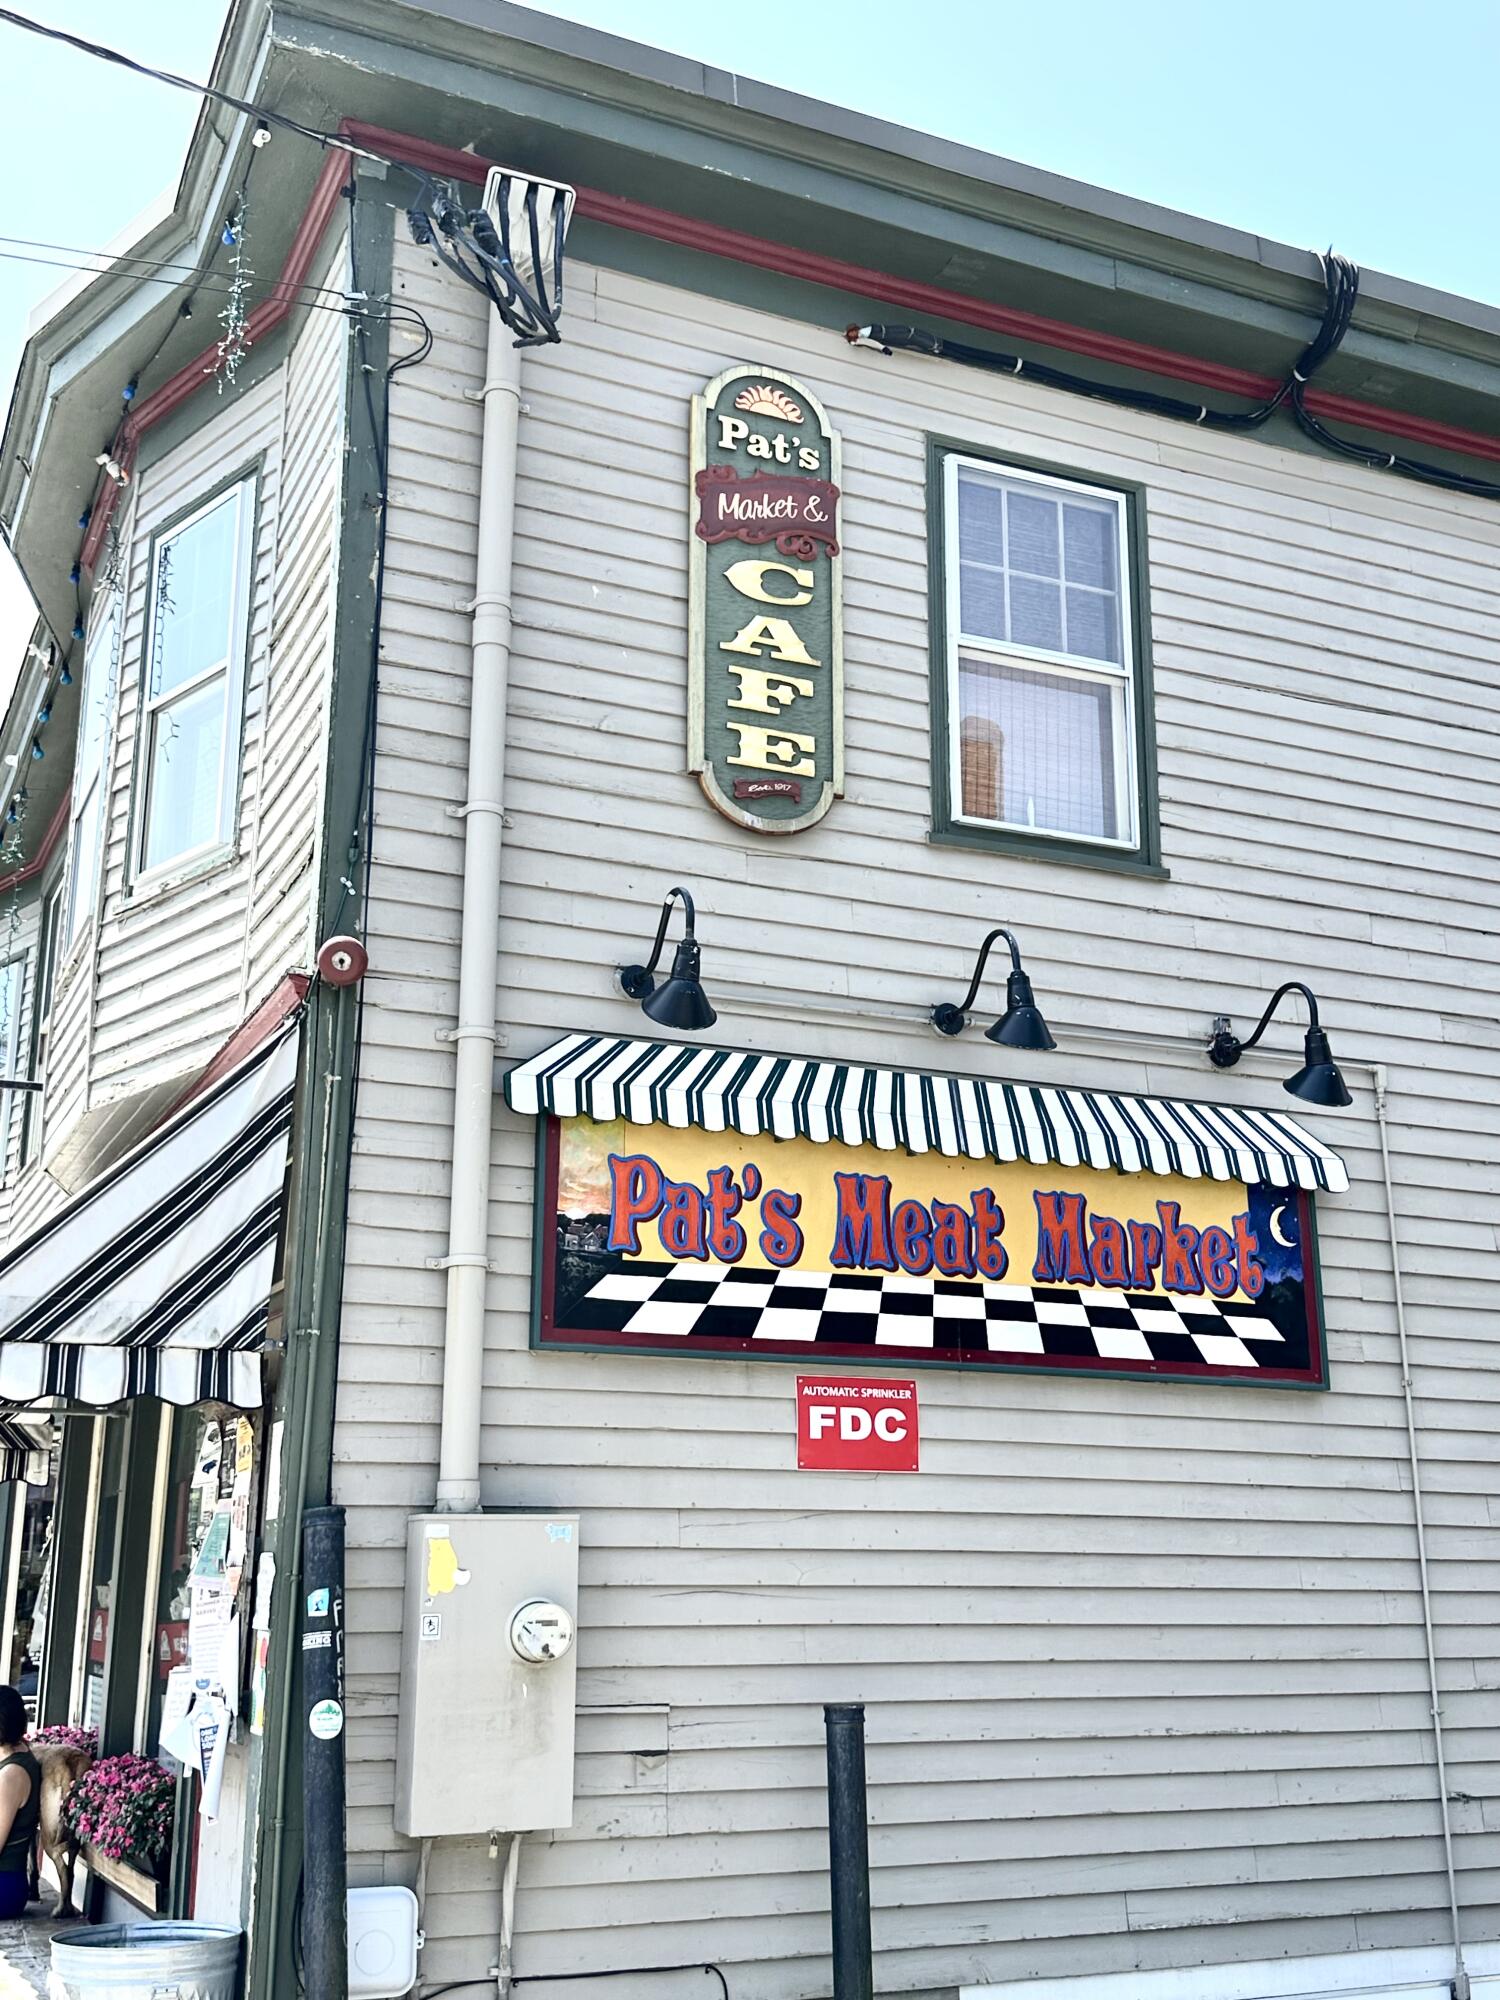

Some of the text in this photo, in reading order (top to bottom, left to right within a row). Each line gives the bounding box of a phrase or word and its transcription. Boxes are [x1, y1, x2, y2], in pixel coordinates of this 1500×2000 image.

[718, 414, 820, 471] Pat's
[718, 492, 829, 522] Market &
[720, 559, 822, 778] CAFE
[607, 1152, 1266, 1299] Pat's Meat Market
[802, 1386, 912, 1399] AUTOMATIC SPRINKLER
[809, 1405, 908, 1442] FDC
